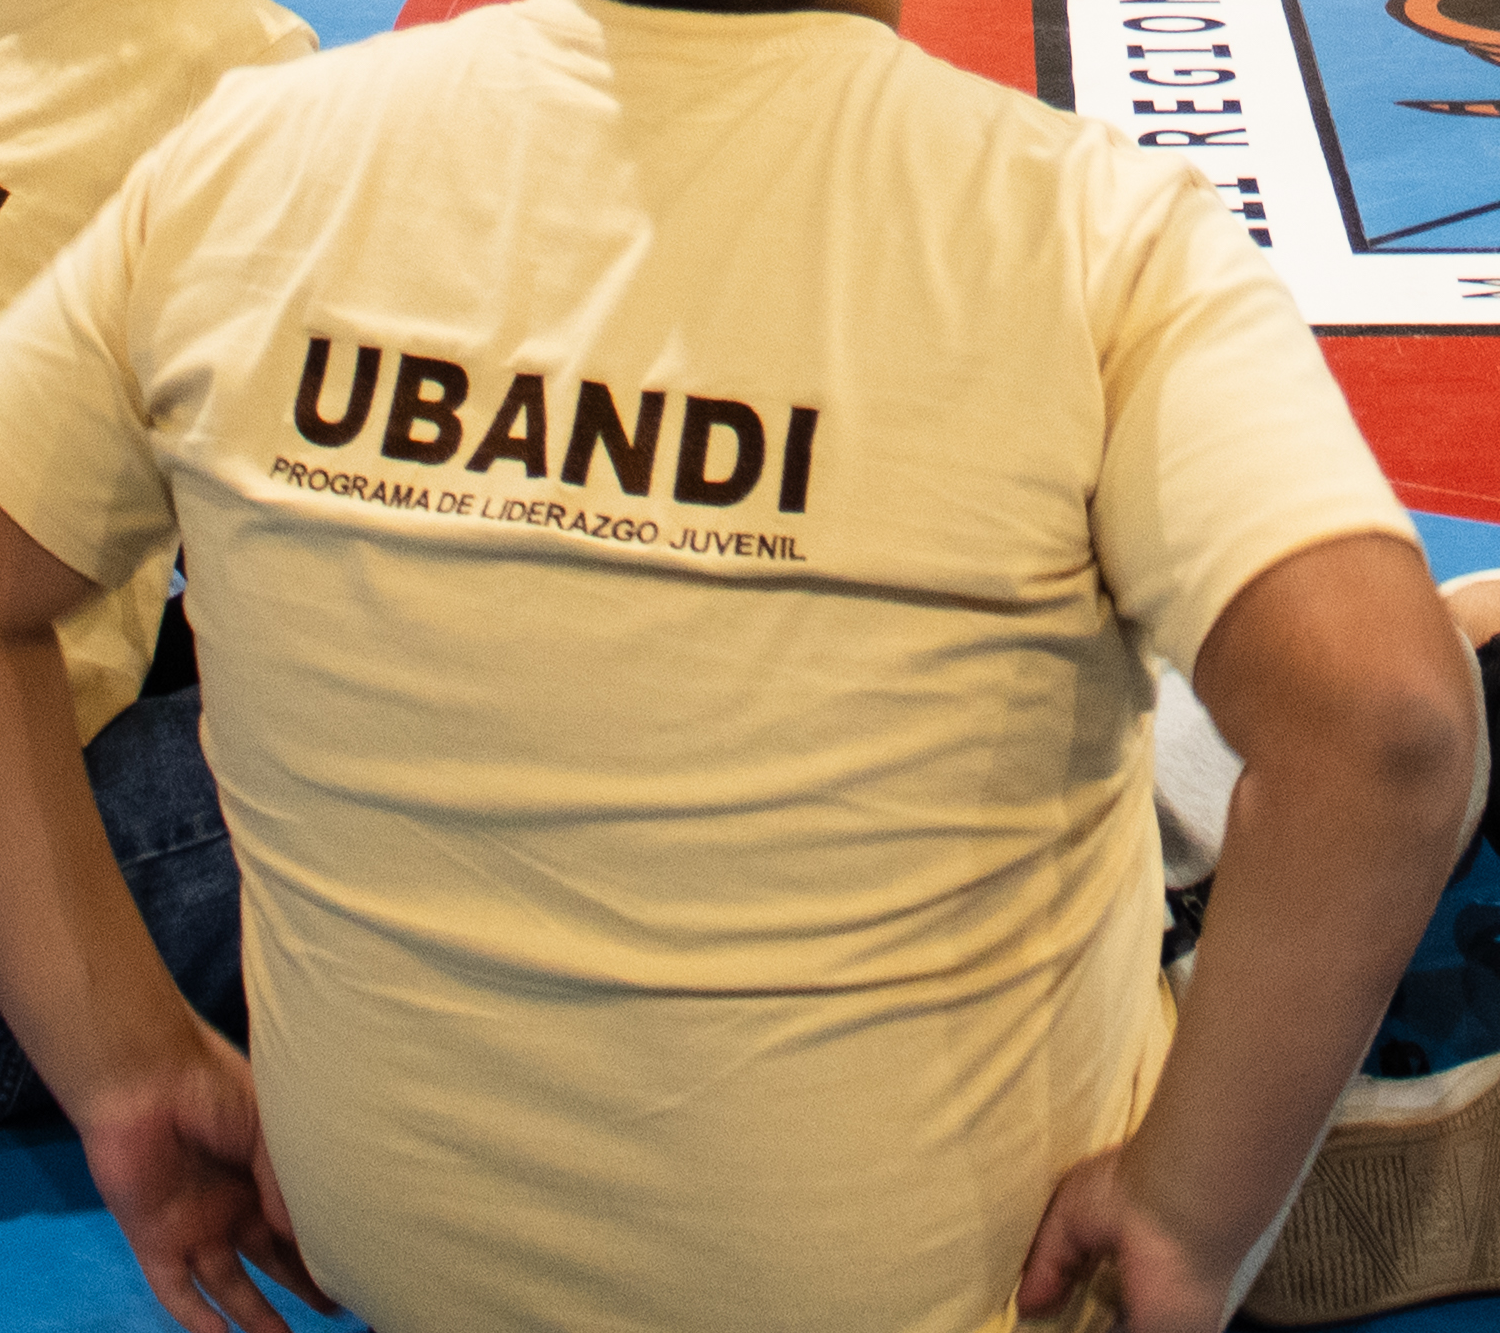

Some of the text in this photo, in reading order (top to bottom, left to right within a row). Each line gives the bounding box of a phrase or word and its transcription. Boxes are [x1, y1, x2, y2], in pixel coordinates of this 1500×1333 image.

[294, 337, 820, 514] UBANDI
[270, 456, 807, 562] PROGRAMA DE LIDERAZGO JUVENIL
